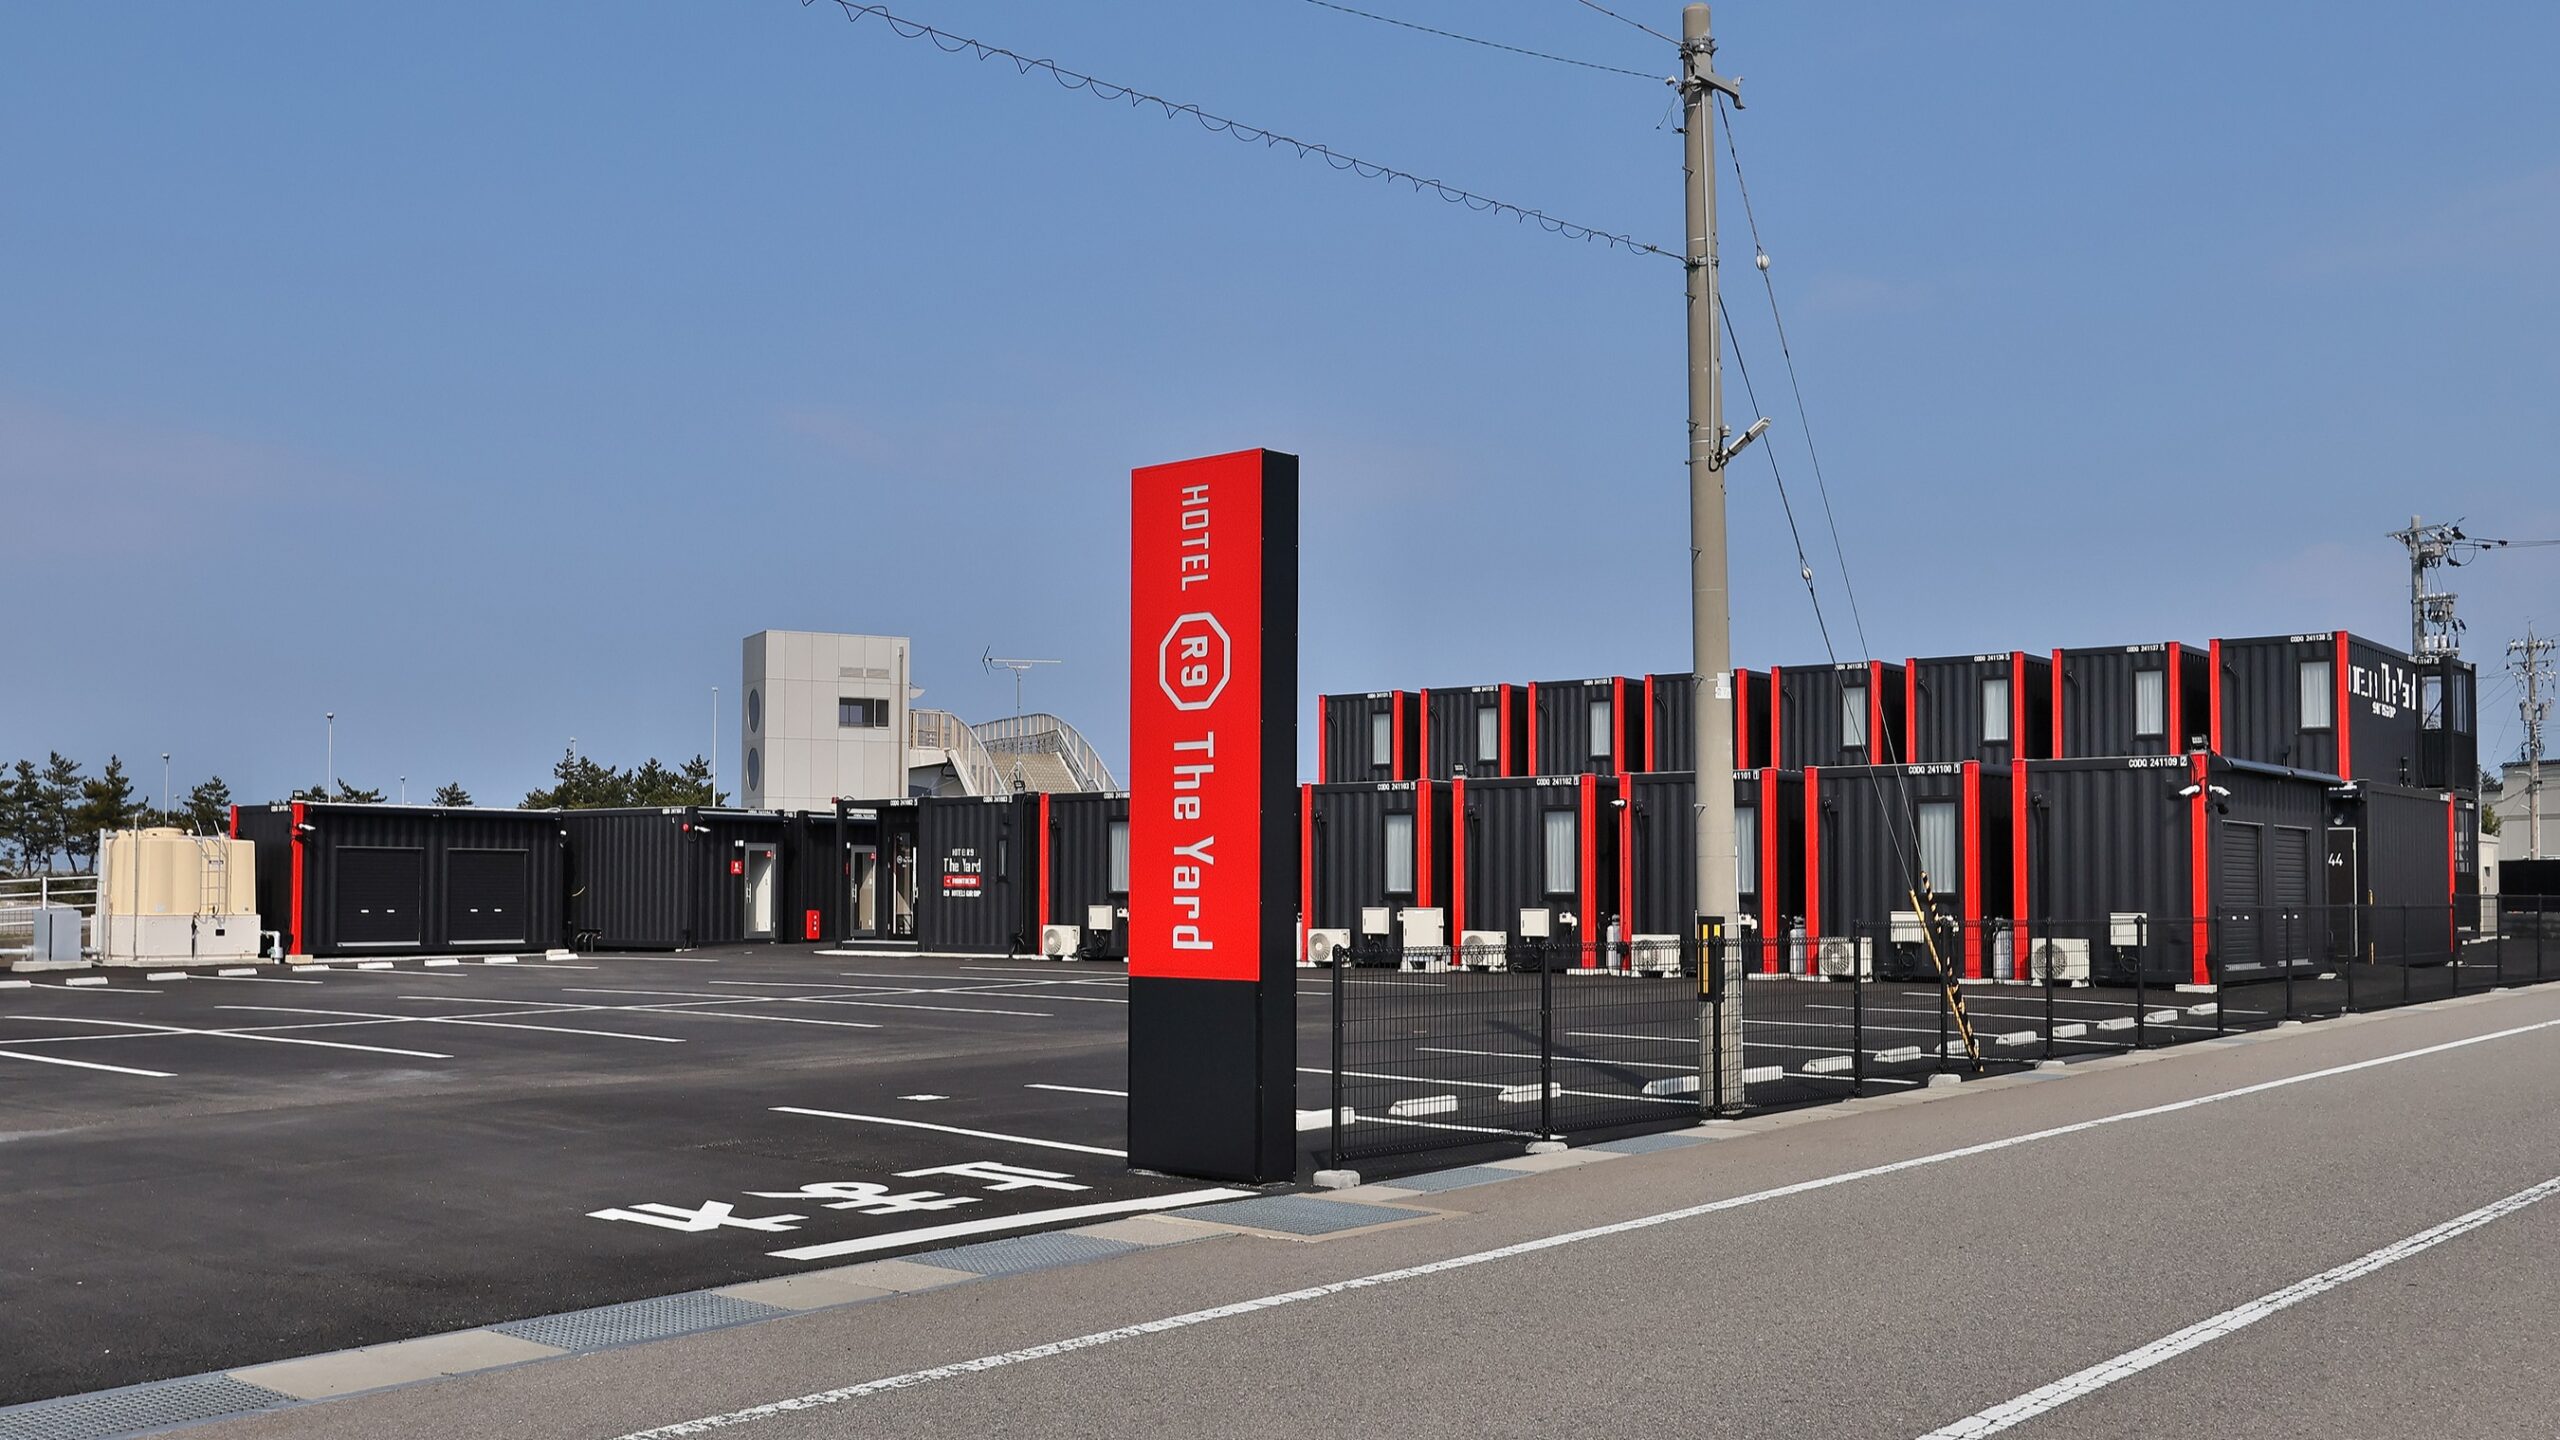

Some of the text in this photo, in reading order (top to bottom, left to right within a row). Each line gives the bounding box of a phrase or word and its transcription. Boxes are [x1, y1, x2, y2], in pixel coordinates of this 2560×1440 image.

[1172, 484, 1214, 950] HOTEL R9 The Yard
[1927, 764, 1951, 774] 241100
[2149, 757, 2177, 767] 241109
[1733, 771, 1751, 780] 41101
[943, 857, 981, 873] The Yard
[2328, 852, 2344, 867] 44
[585, 1160, 1093, 1232] 止まれ
